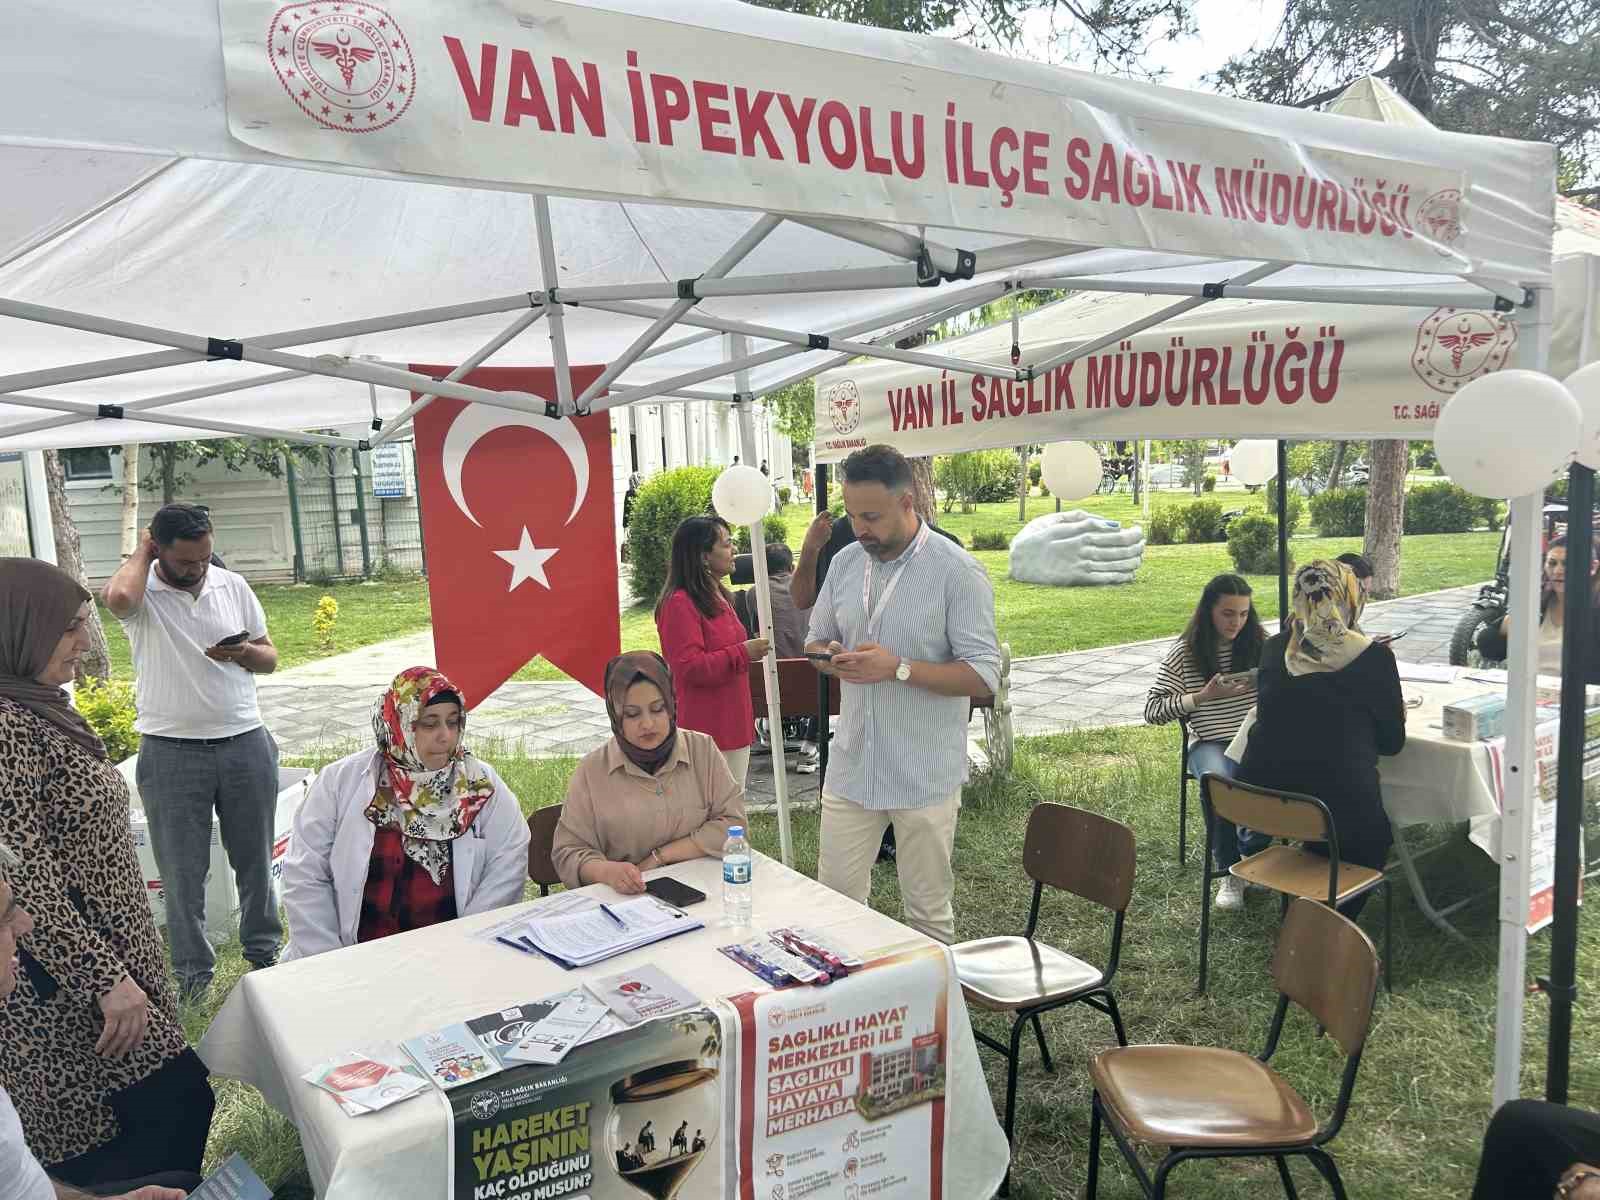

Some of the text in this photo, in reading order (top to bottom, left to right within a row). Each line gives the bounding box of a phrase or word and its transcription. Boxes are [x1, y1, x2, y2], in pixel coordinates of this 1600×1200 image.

[442, 36, 606, 138] VAN
[626, 50, 926, 179] İPEKYOLU
[944, 101, 1050, 209] İLÇE
[888, 383, 933, 432] VAN
[941, 368, 963, 426] İL
[1086, 325, 1345, 408] MÜDÜRLÜĞÜ
[1393, 405, 1411, 420] T.C.
[854, 1006, 909, 1033] HAYAT
[768, 1083, 840, 1116] HAYATA
[768, 1098, 856, 1137] MERHABA
[472, 1102, 592, 1154] HAREKET
[472, 1126, 591, 1181] YAŞININ
[474, 1154, 590, 1200] KAÇ OLDUĞUNU
[533, 1173, 592, 1200] MUSUN?
